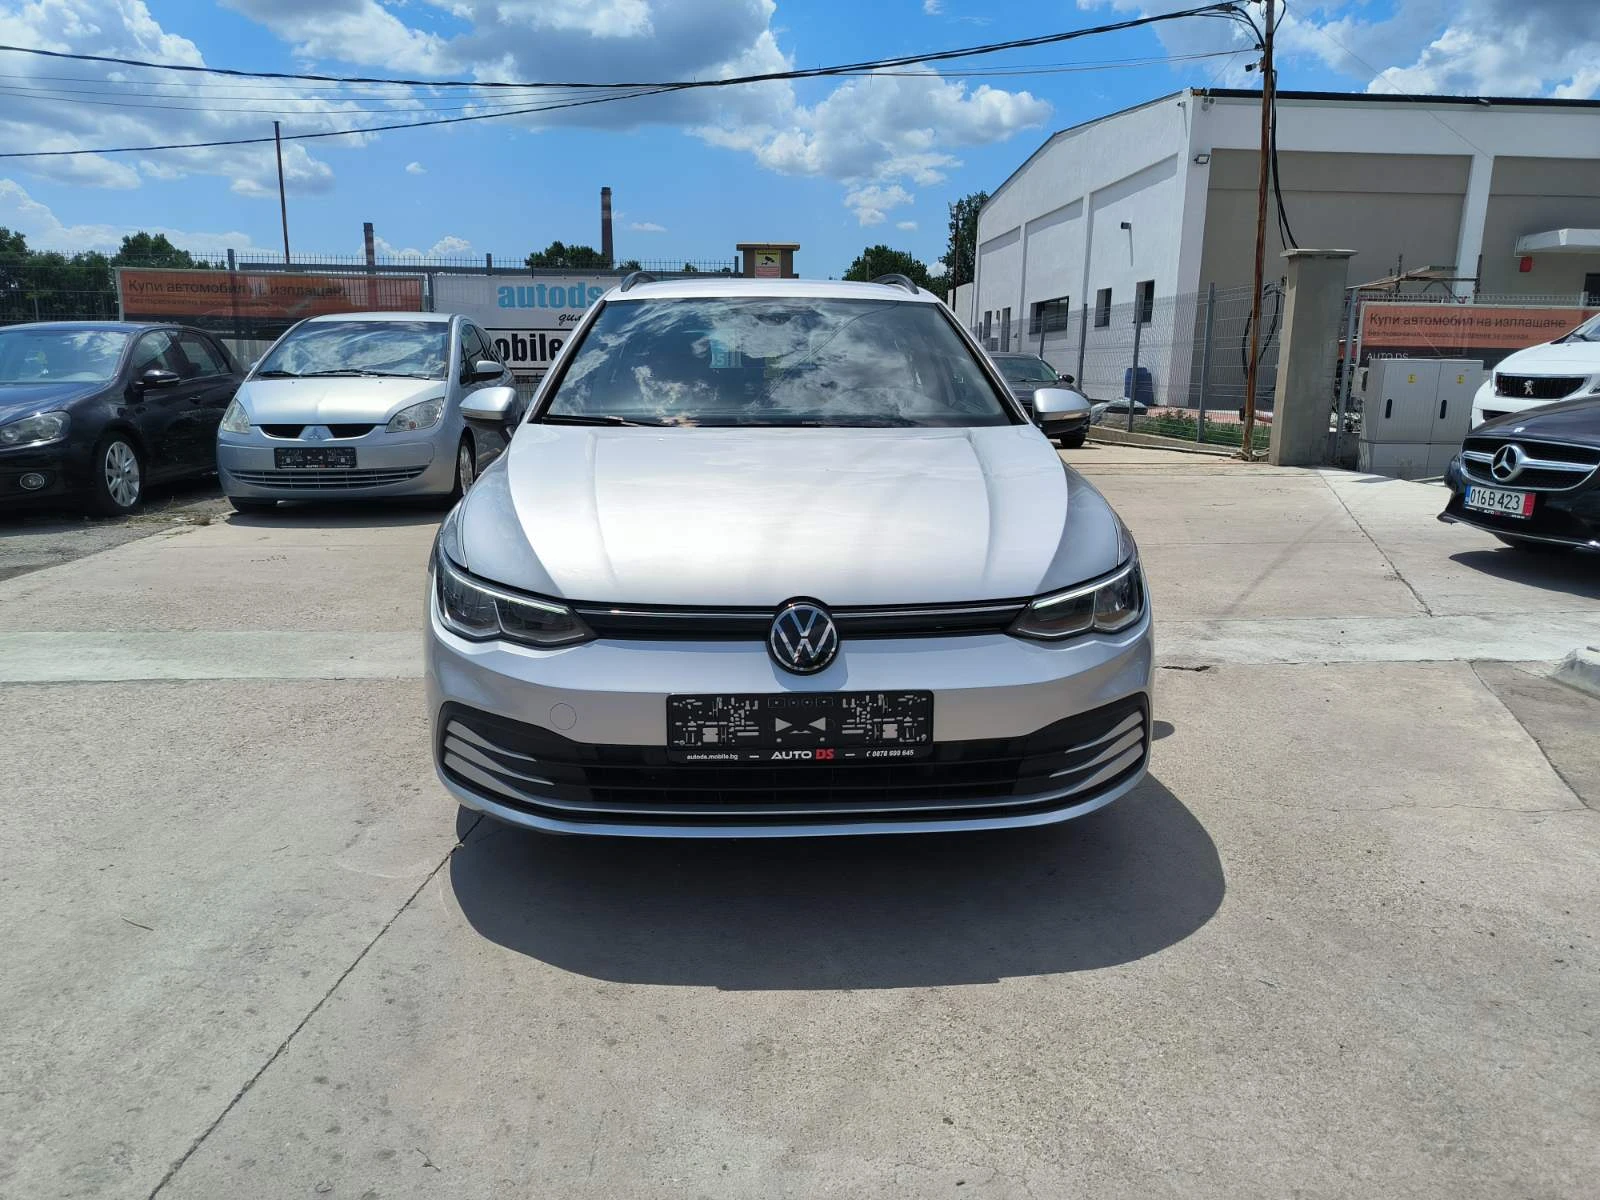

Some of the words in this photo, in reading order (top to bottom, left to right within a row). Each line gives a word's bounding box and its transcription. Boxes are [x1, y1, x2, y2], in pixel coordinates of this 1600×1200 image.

[128, 280, 162, 294] Купи
[166, 282, 246, 294] автомобил
[497, 282, 604, 309] autods
[1369, 313, 1400, 327] Купи
[1403, 314, 1473, 326] автомобил
[1476, 319, 1492, 327] на
[494, 333, 563, 361] obile
[771, 751, 812, 760] AUTO
[815, 749, 835, 760] DS
